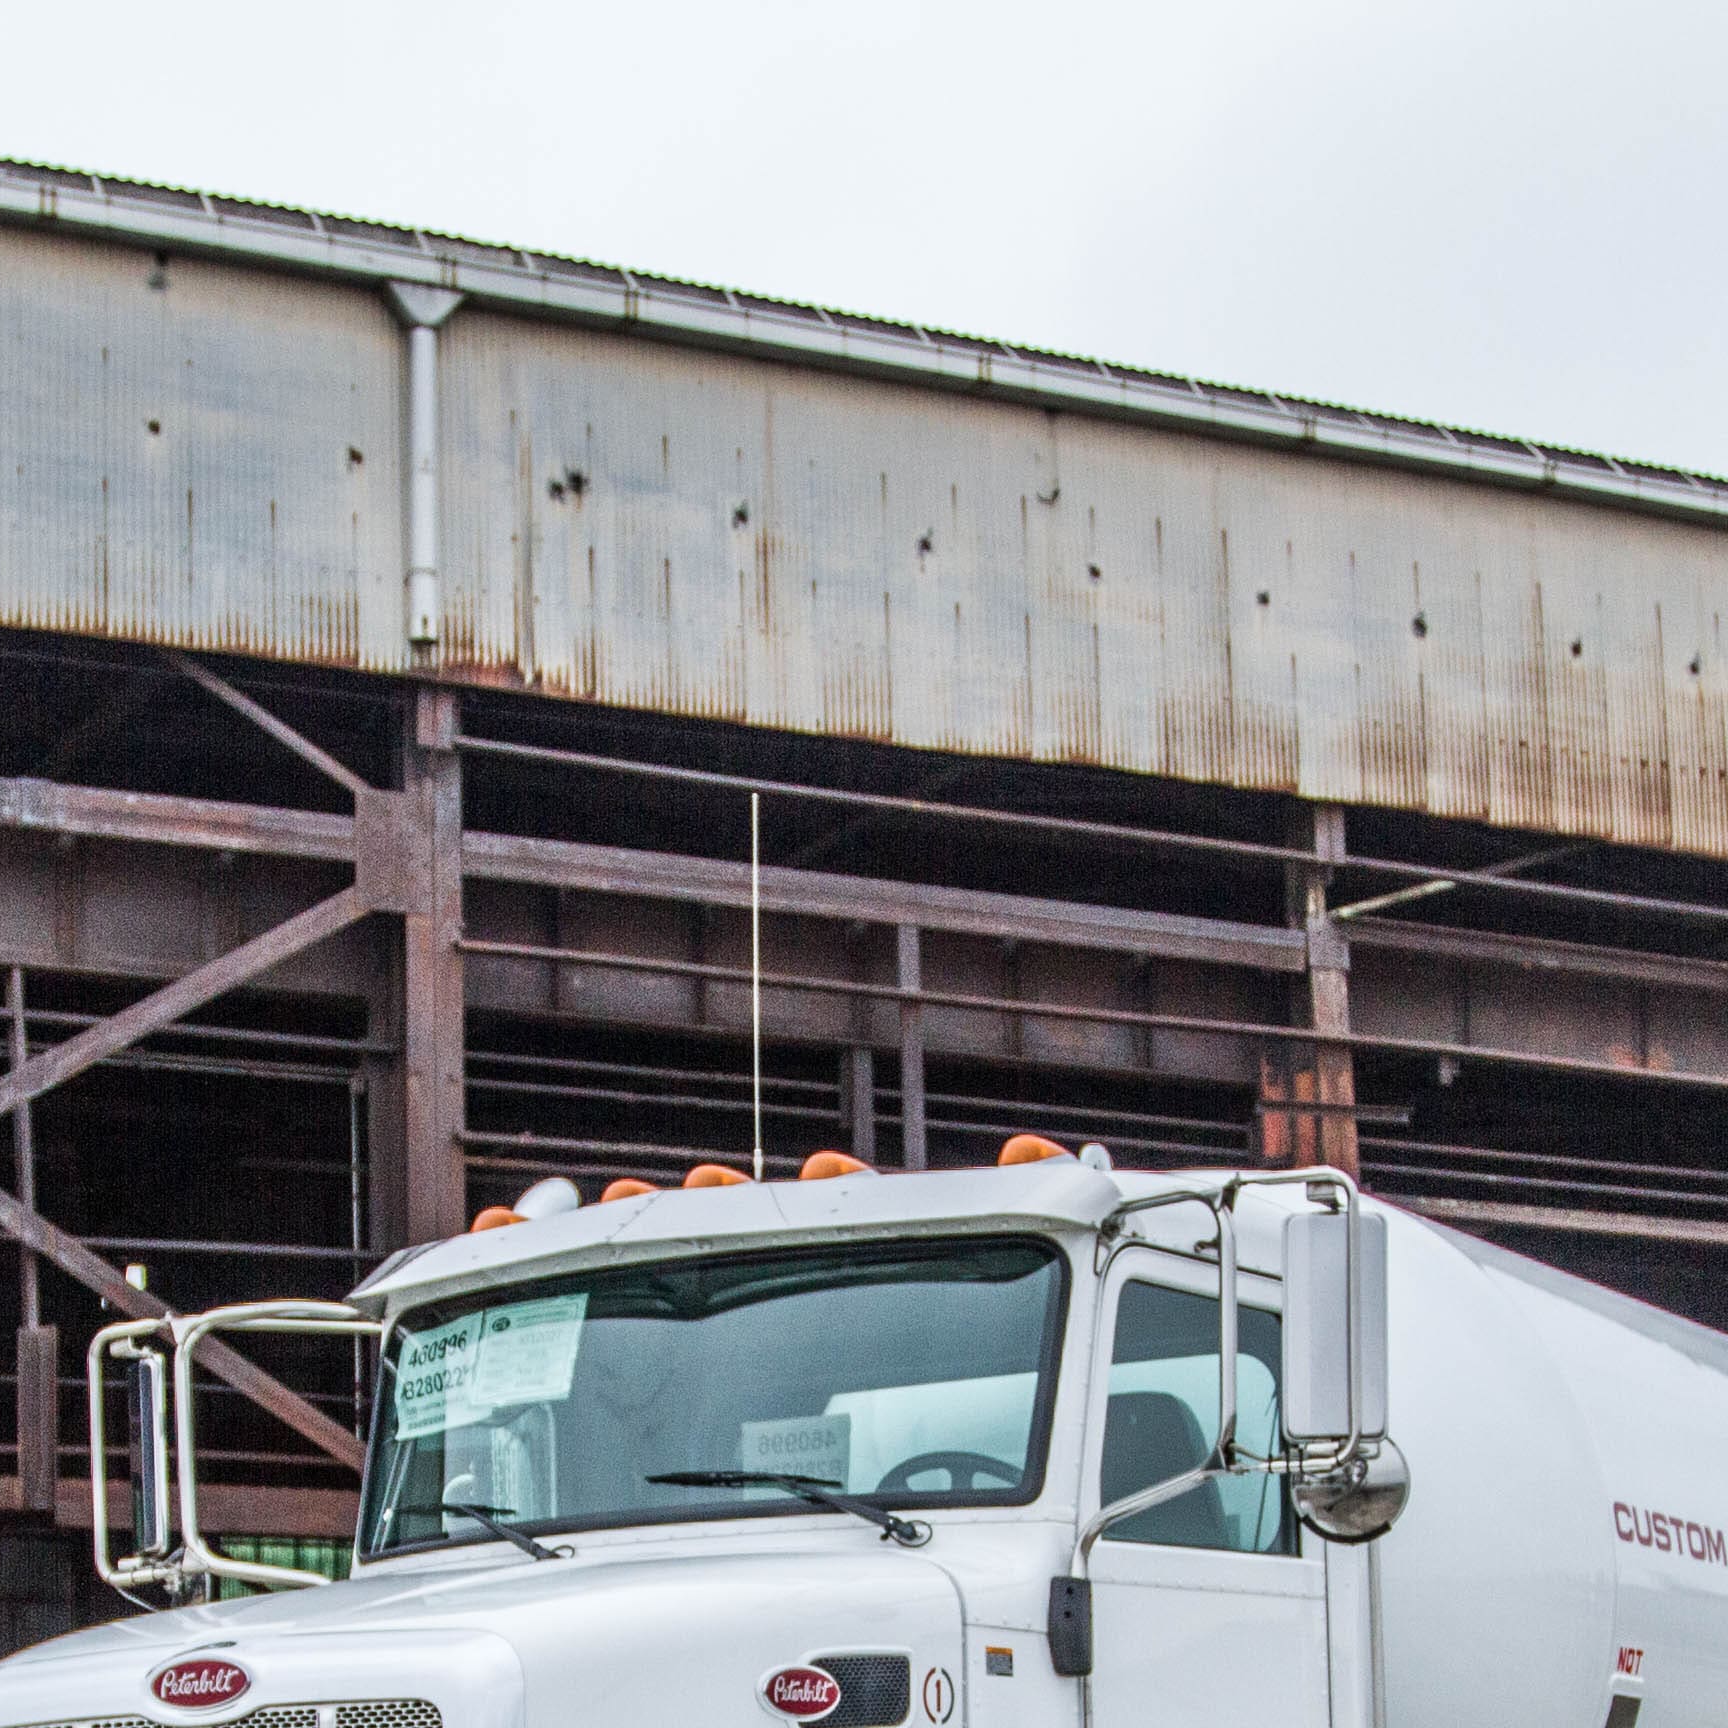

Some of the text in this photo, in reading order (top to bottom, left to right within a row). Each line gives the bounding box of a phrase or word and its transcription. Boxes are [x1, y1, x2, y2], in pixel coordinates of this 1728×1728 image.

[407, 1329, 468, 1368] 460996
[1613, 1501, 1728, 1567] CUSTOM
[160, 1668, 240, 1699] Peterbilt
[773, 1676, 834, 1703] Peterbilt
